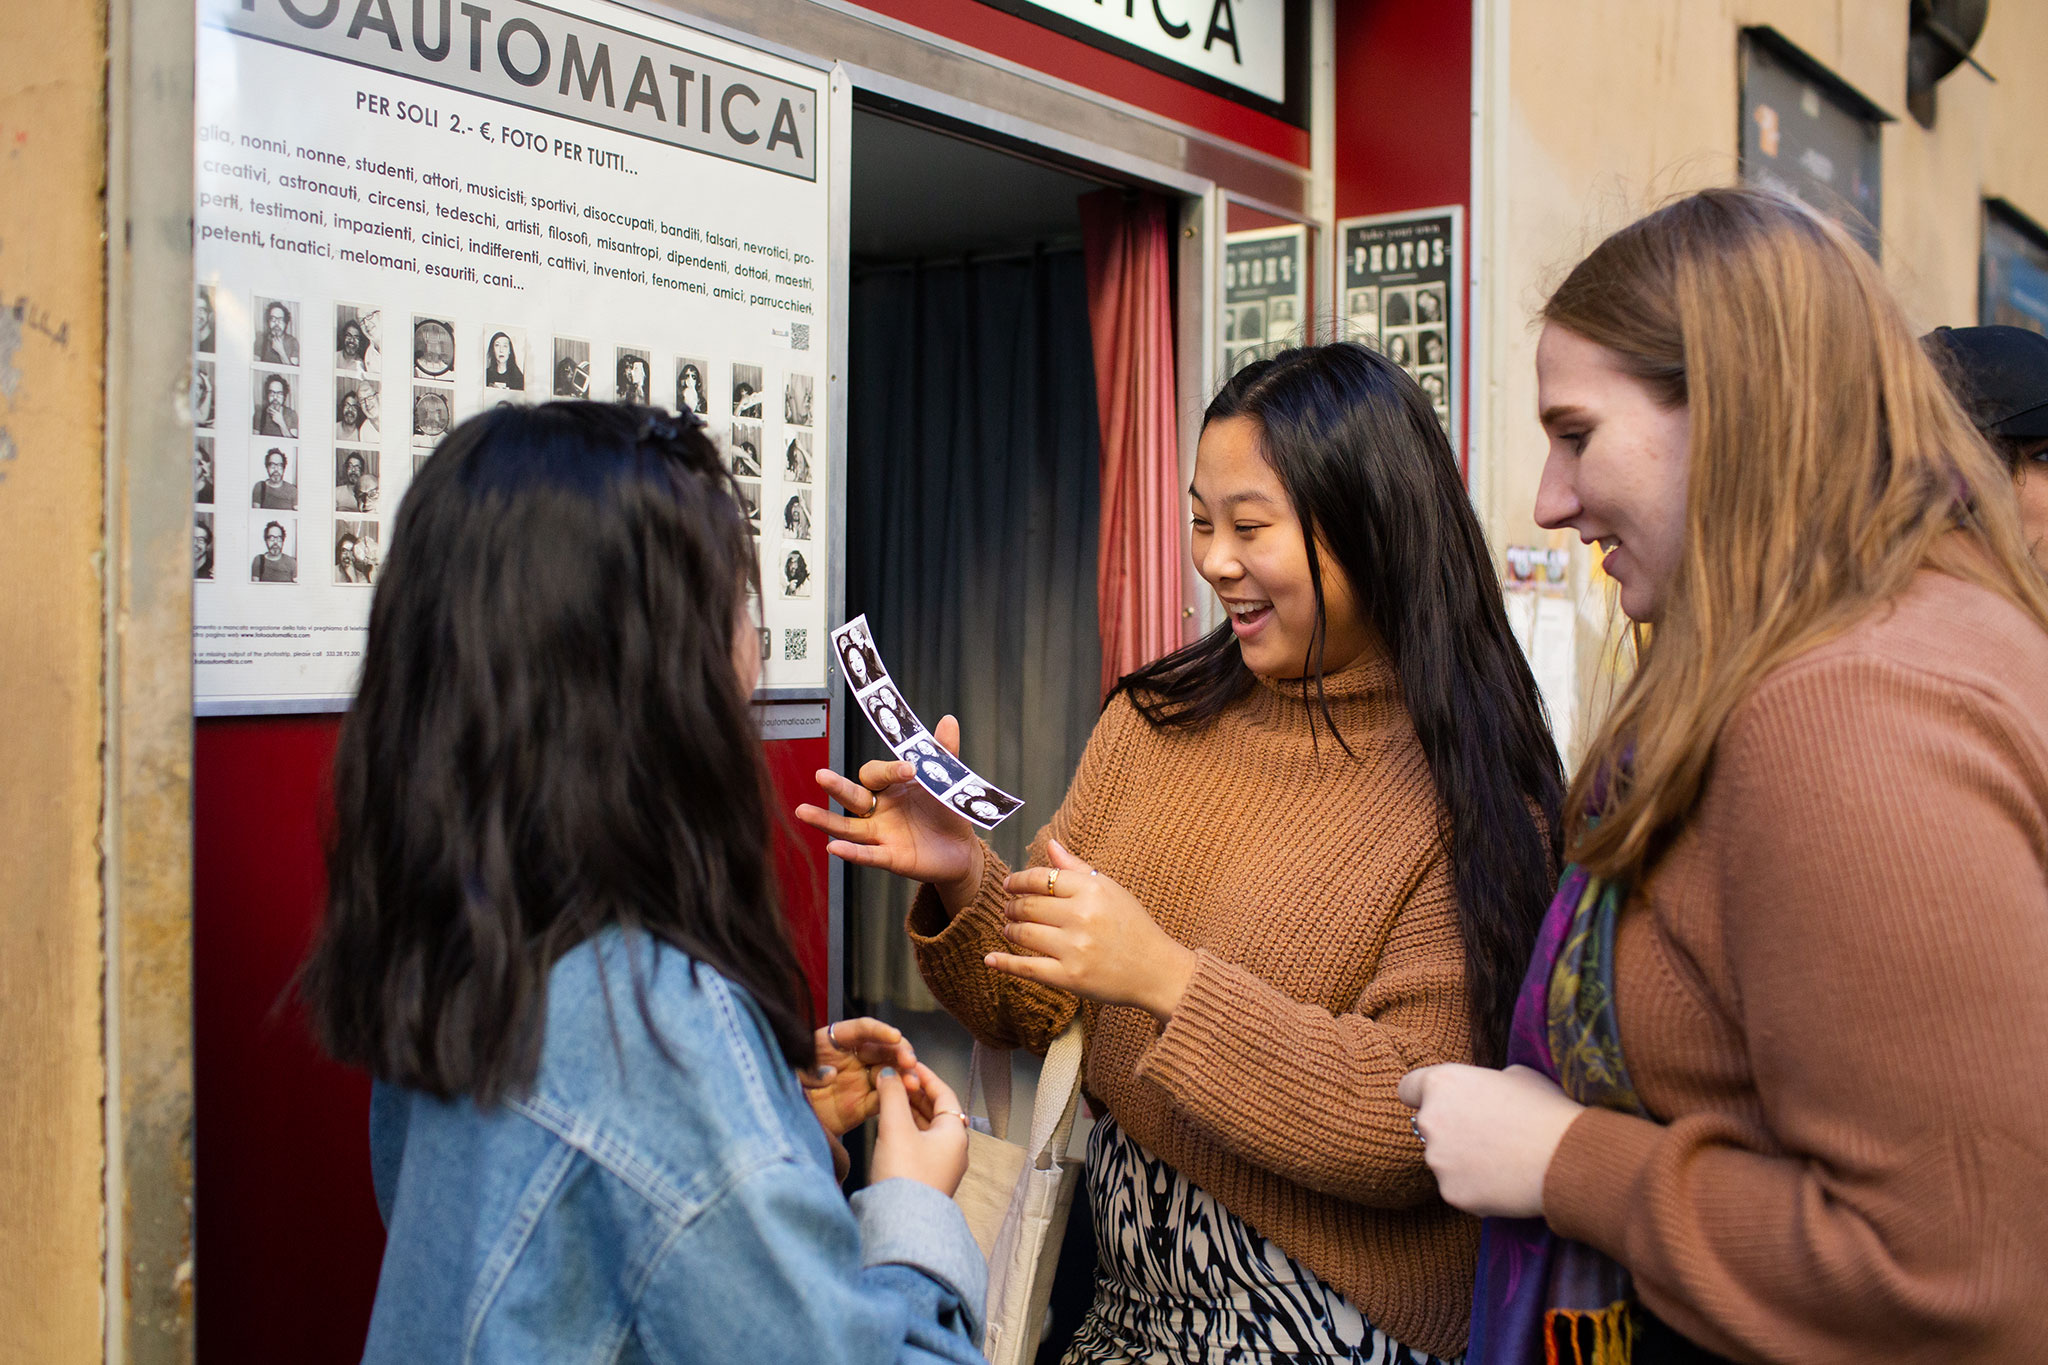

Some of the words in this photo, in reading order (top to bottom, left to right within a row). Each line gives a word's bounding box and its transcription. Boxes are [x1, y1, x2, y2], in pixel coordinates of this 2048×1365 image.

[241, 0, 805, 160] AUTOMATICA
[356, 91, 390, 117] PER
[396, 101, 438, 128] SOLI
[480, 122, 495, 143] €,
[501, 126, 548, 153] FOTO
[554, 139, 583, 162] PER
[587, 147, 638, 175] TUTTI...
[195, 225, 265, 249] petenti,
[270, 233, 335, 260] fanatici,
[340, 249, 420, 274] melomani,
[425, 264, 479, 284] esauriti,
[483, 274, 525, 290] cani...
[200, 191, 244, 213] perti,
[250, 197, 327, 228] testimoni,
[334, 212, 416, 244] impazienti,
[421, 231, 464, 252] cinici,
[469, 238, 542, 266] indifferenti,
[547, 255, 589, 275] cattivi,
[593, 261, 648, 286] inventori,
[652, 272, 709, 296] fenomeni,
[713, 287, 746, 303] amici,
[750, 294, 815, 316] parrucchieri,
[203, 159, 271, 186] creativi,
[279, 175, 361, 203] astronauti,
[368, 190, 430, 216] circensi,
[436, 202, 500, 229] tedeschi,
[505, 219, 543, 238] artisti,
[548, 225, 591, 247] filosofi,
[596, 236, 662, 262] misantropi,
[666, 249, 730, 275] dipendenti,
[734, 263, 771, 283] dottori,
[775, 273, 815, 291] maestri,
[241, 134, 291, 158] nonni,
[296, 146, 351, 170] nonne,
[355, 157, 418, 184] studenti,
[422, 172, 462, 193] attori,
[467, 182, 528, 206] musicisti,
[531, 196, 580, 217] sportivi,
[583, 205, 657, 233] disoccupati,
[660, 221, 703, 243] banditi,
[705, 231, 741, 251] falsari,
[743, 241, 791, 262] nevrotici,
[793, 252, 815, 265] pro-
[1354, 238, 1444, 274] PHOTOS
